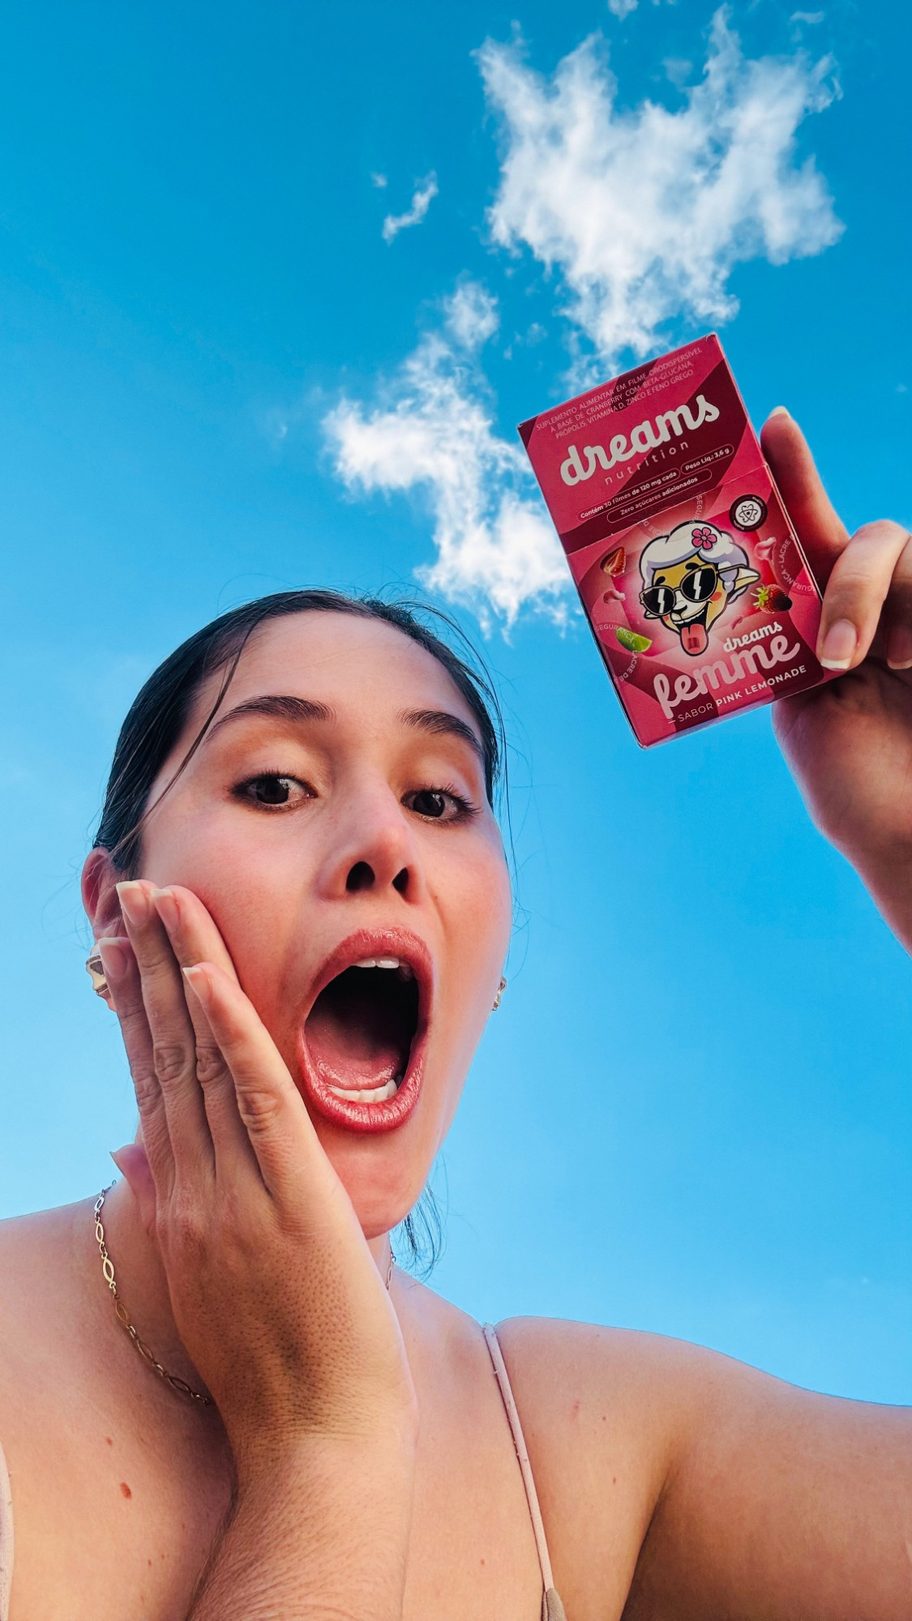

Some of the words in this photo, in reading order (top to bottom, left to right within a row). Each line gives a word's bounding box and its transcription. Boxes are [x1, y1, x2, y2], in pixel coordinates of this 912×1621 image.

[536, 407, 577, 431] SUPLEMENTO
[580, 389, 614, 410] ALIMENTAR
[628, 373, 646, 387] FILME
[557, 419, 573, 430] BASE
[575, 412, 585, 421] DE
[586, 394, 622, 415] CRANBERRY
[625, 385, 641, 397] COM
[587, 405, 618, 424] VITAMINA
[626, 391, 647, 406] ZINCO
[652, 380, 670, 393] FENO
[670, 369, 694, 384] GREGO
[560, 394, 720, 486] dreams
[604, 441, 689, 485] nutrition
[685, 461, 700, 471] Peso
[713, 450, 724, 458] 3,6
[580, 505, 604, 518] Contém
[640, 483, 650, 491] 120
[650, 478, 662, 487] mg
[661, 471, 677, 481] cada
[620, 506, 635, 515] Zero
[662, 477, 698, 496] adicionados
[779, 539, 791, 563] LACRE
[723, 621, 783, 653] dreams
[653, 634, 801, 720] femme
[677, 702, 714, 723] SABOR
[716, 691, 743, 707] PINK
[744, 664, 807, 695] LEMONADE
